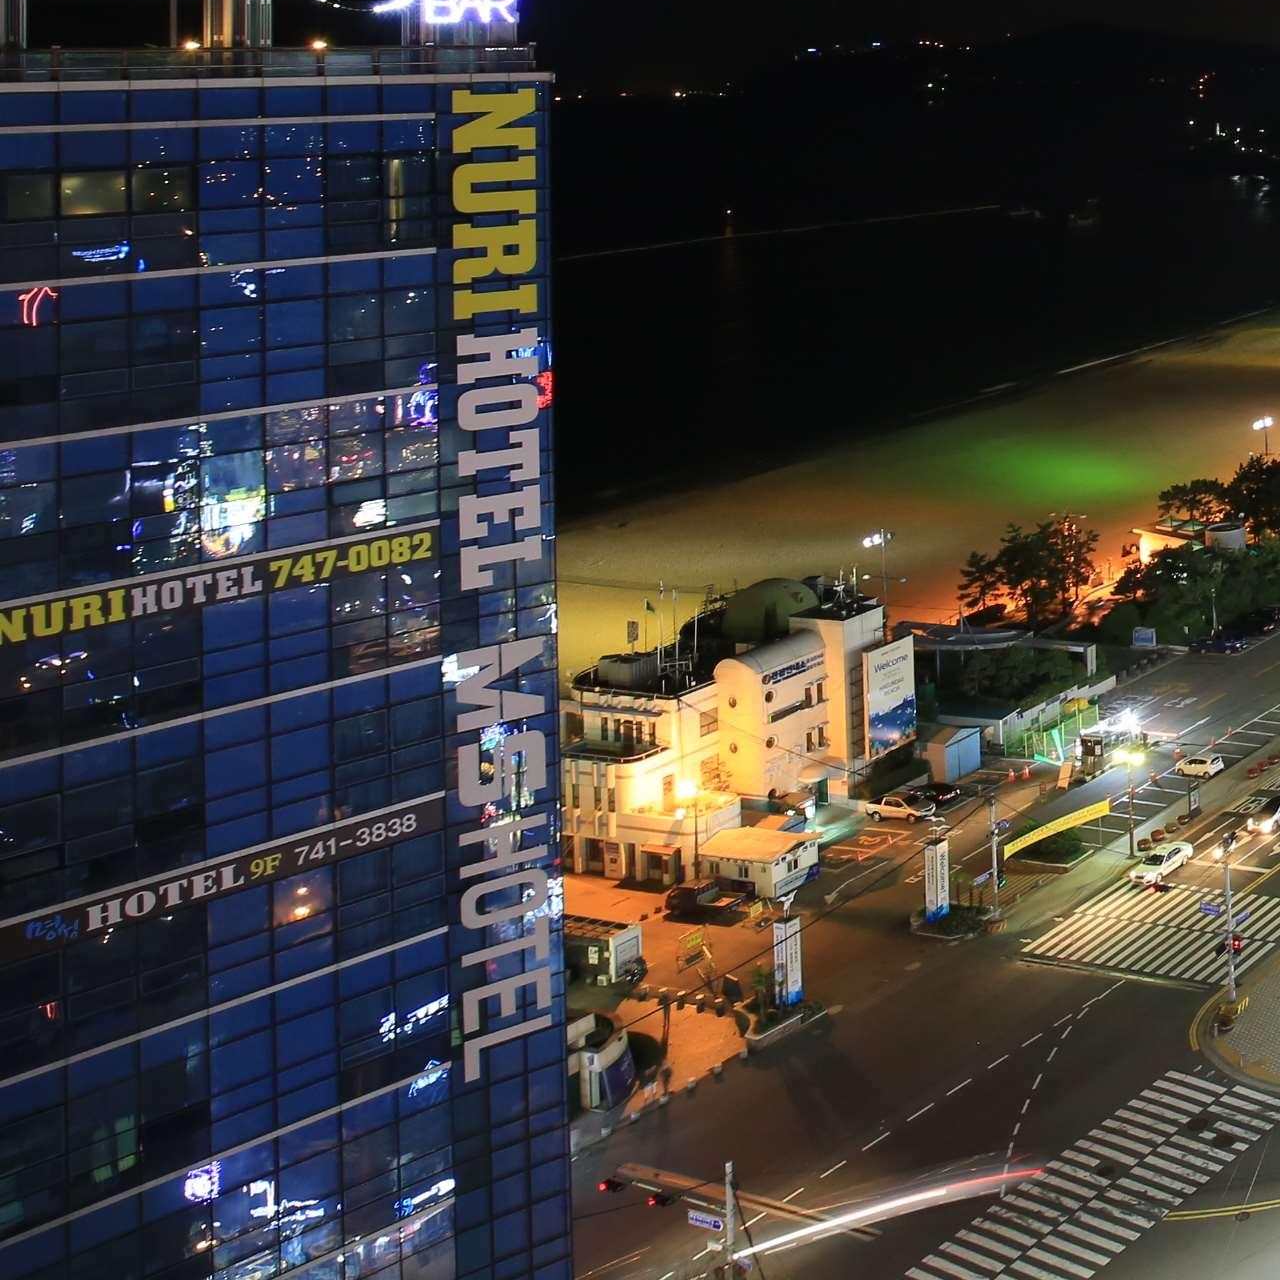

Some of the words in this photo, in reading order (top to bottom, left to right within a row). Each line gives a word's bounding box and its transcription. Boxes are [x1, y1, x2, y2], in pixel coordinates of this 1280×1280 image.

[452, 88, 538, 319] NURI
[455, 327, 543, 590] HOTEL
[0, 589, 126, 646] NURI
[131, 565, 263, 618] HOTEL
[269, 532, 432, 588] 747-0082
[874, 654, 909, 674] Welcome
[86, 863, 245, 930] HOTEL
[249, 852, 284, 881] 9F
[294, 813, 418, 867] 741-3838
[459, 813, 552, 1084] HOTEL
